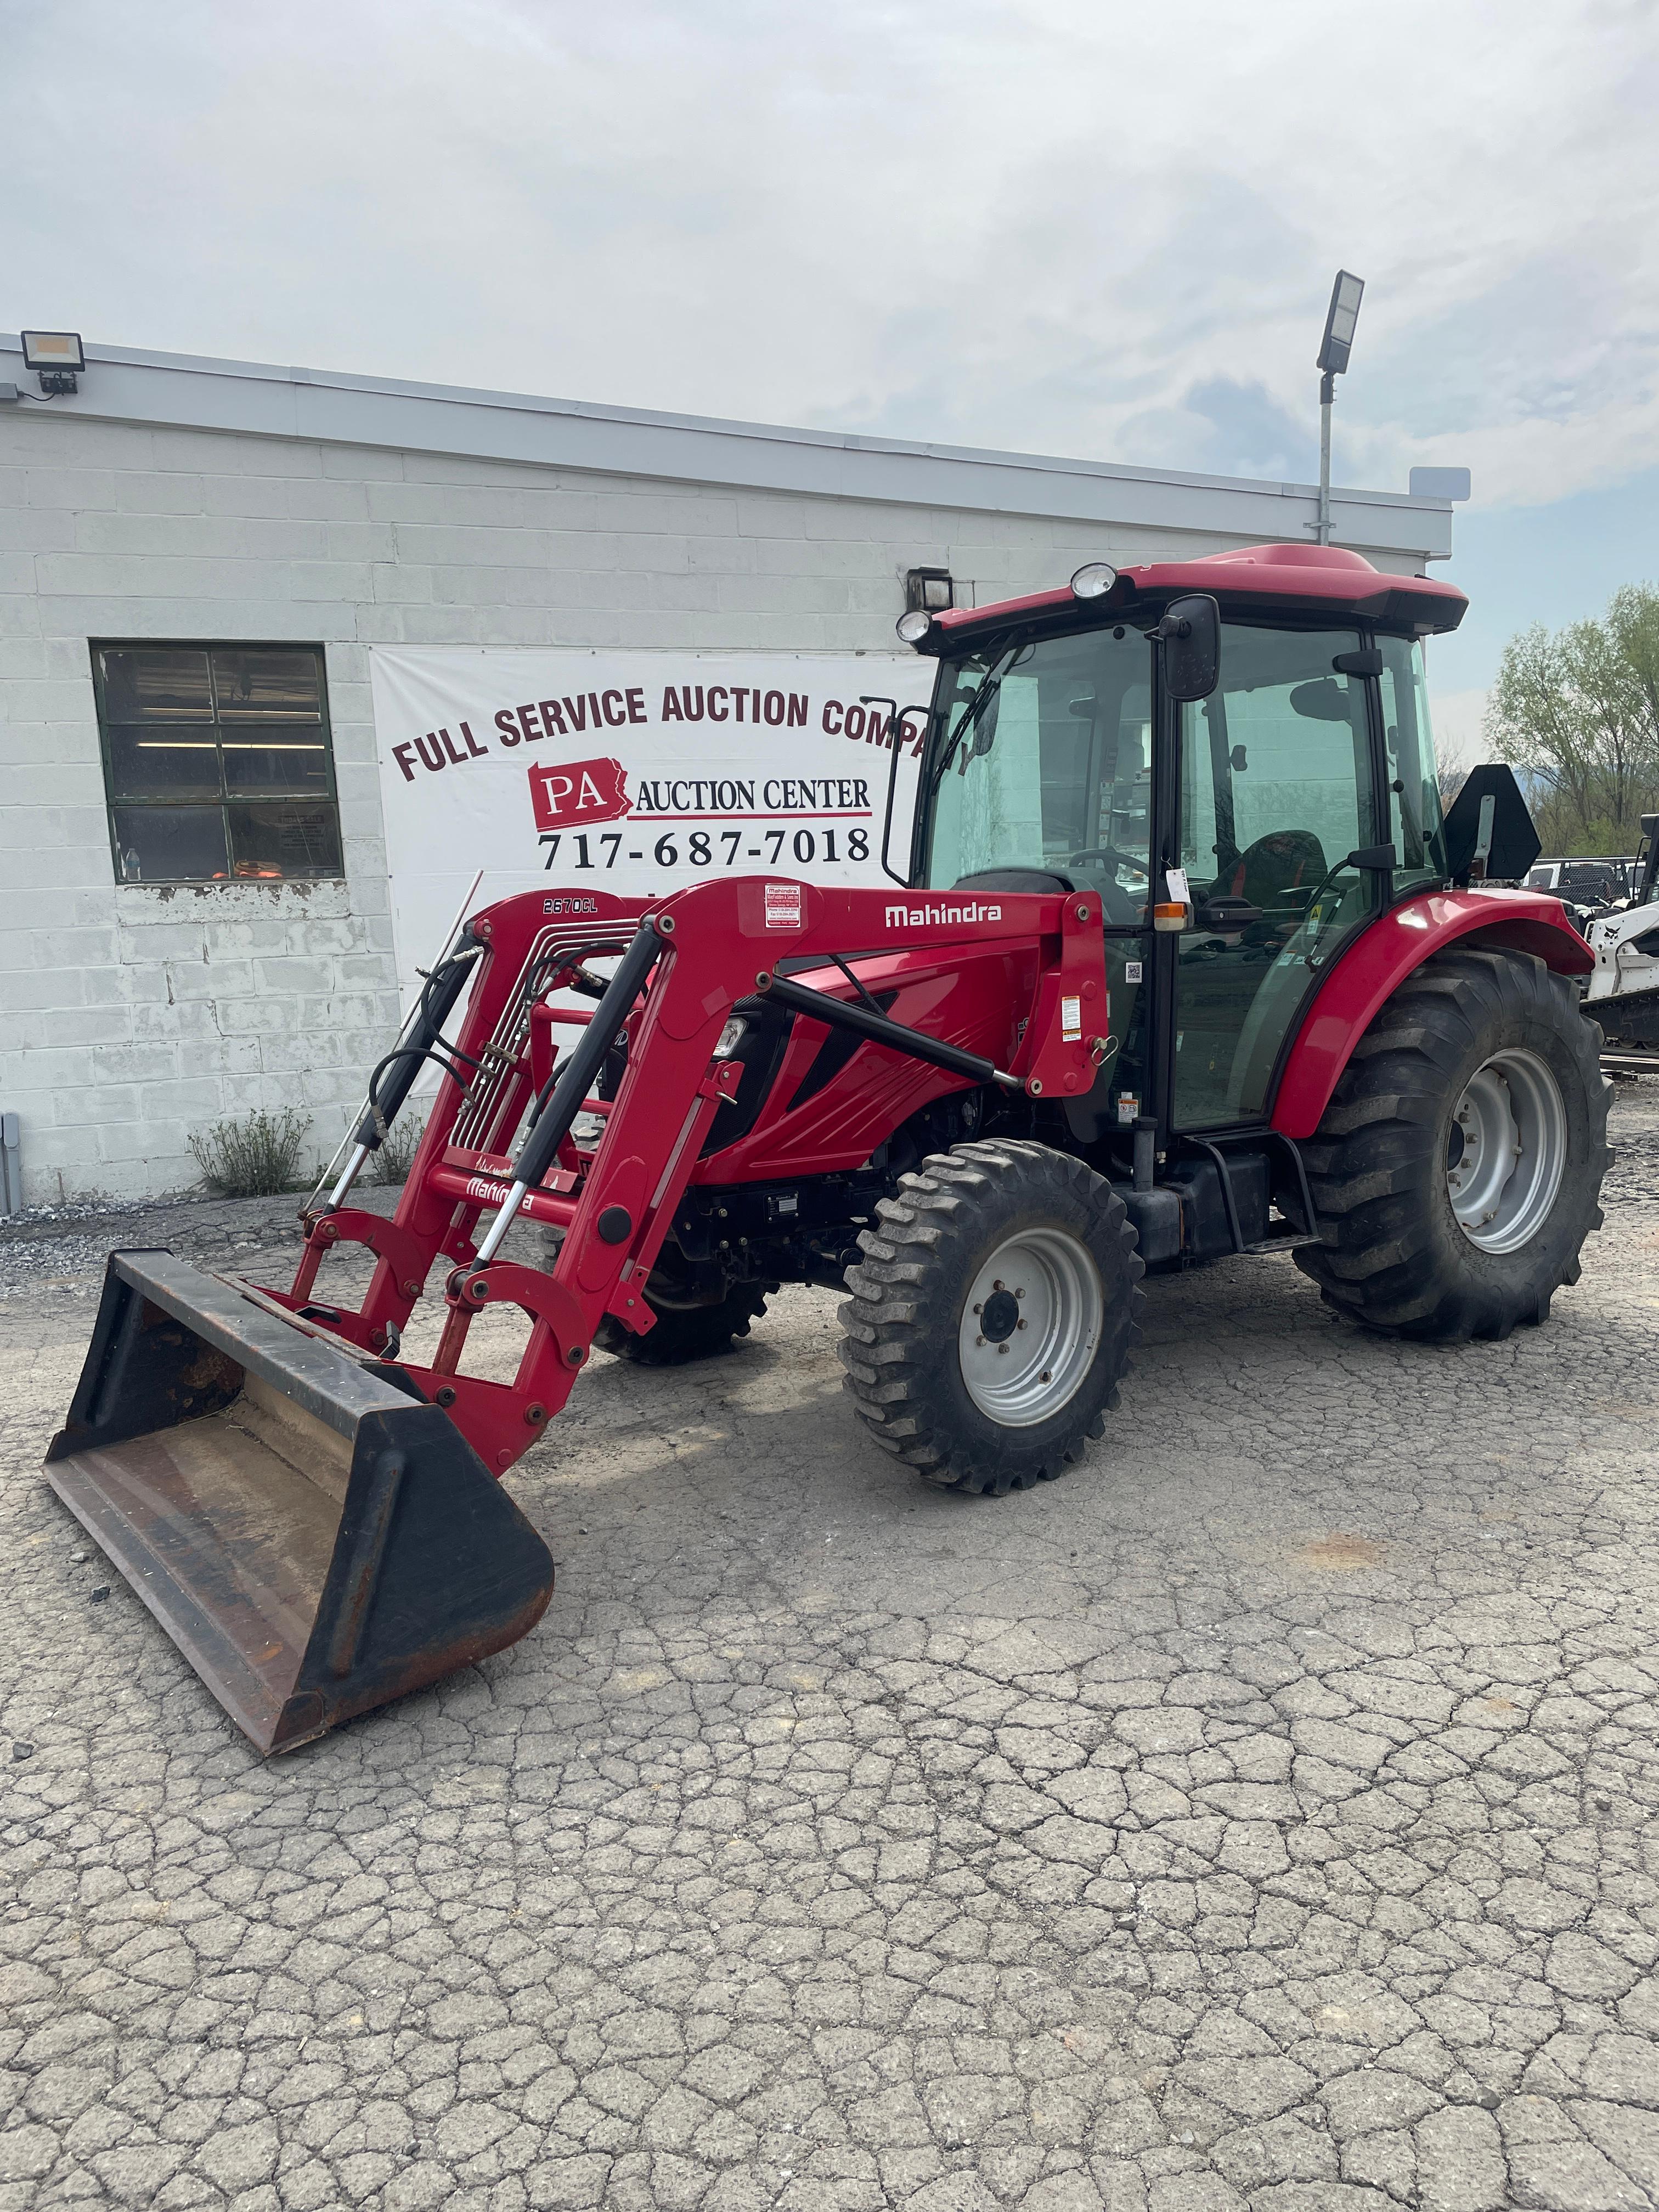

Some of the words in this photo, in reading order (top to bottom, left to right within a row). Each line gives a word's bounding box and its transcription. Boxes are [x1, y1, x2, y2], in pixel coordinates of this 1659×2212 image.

[391, 721, 489, 782] FULL
[494, 687, 648, 747] SERVICE
[661, 685, 809, 727] AUCTION
[540, 770, 607, 815] PA
[636, 780, 755, 811] AUCTION
[763, 778, 871, 809] CENTER
[537, 828, 870, 870] 717-687-7018
[543, 898, 598, 915] 2670CL
[885, 901, 1002, 928] Mahindra
[466, 1177, 535, 1211] Mahina
